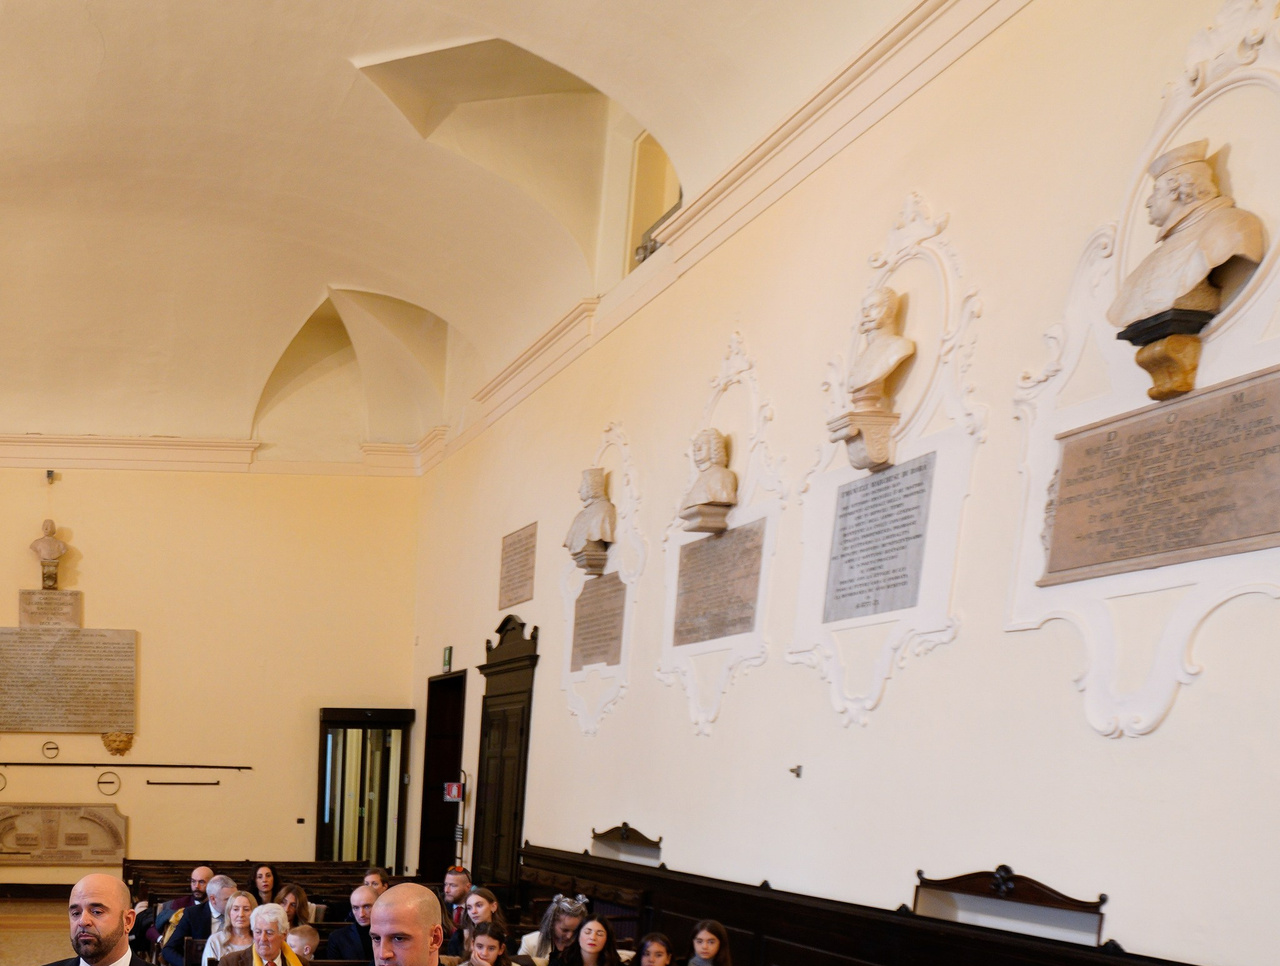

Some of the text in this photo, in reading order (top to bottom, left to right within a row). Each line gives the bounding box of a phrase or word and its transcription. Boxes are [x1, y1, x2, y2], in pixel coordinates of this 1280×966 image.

[1106, 392, 1245, 442] D O M
